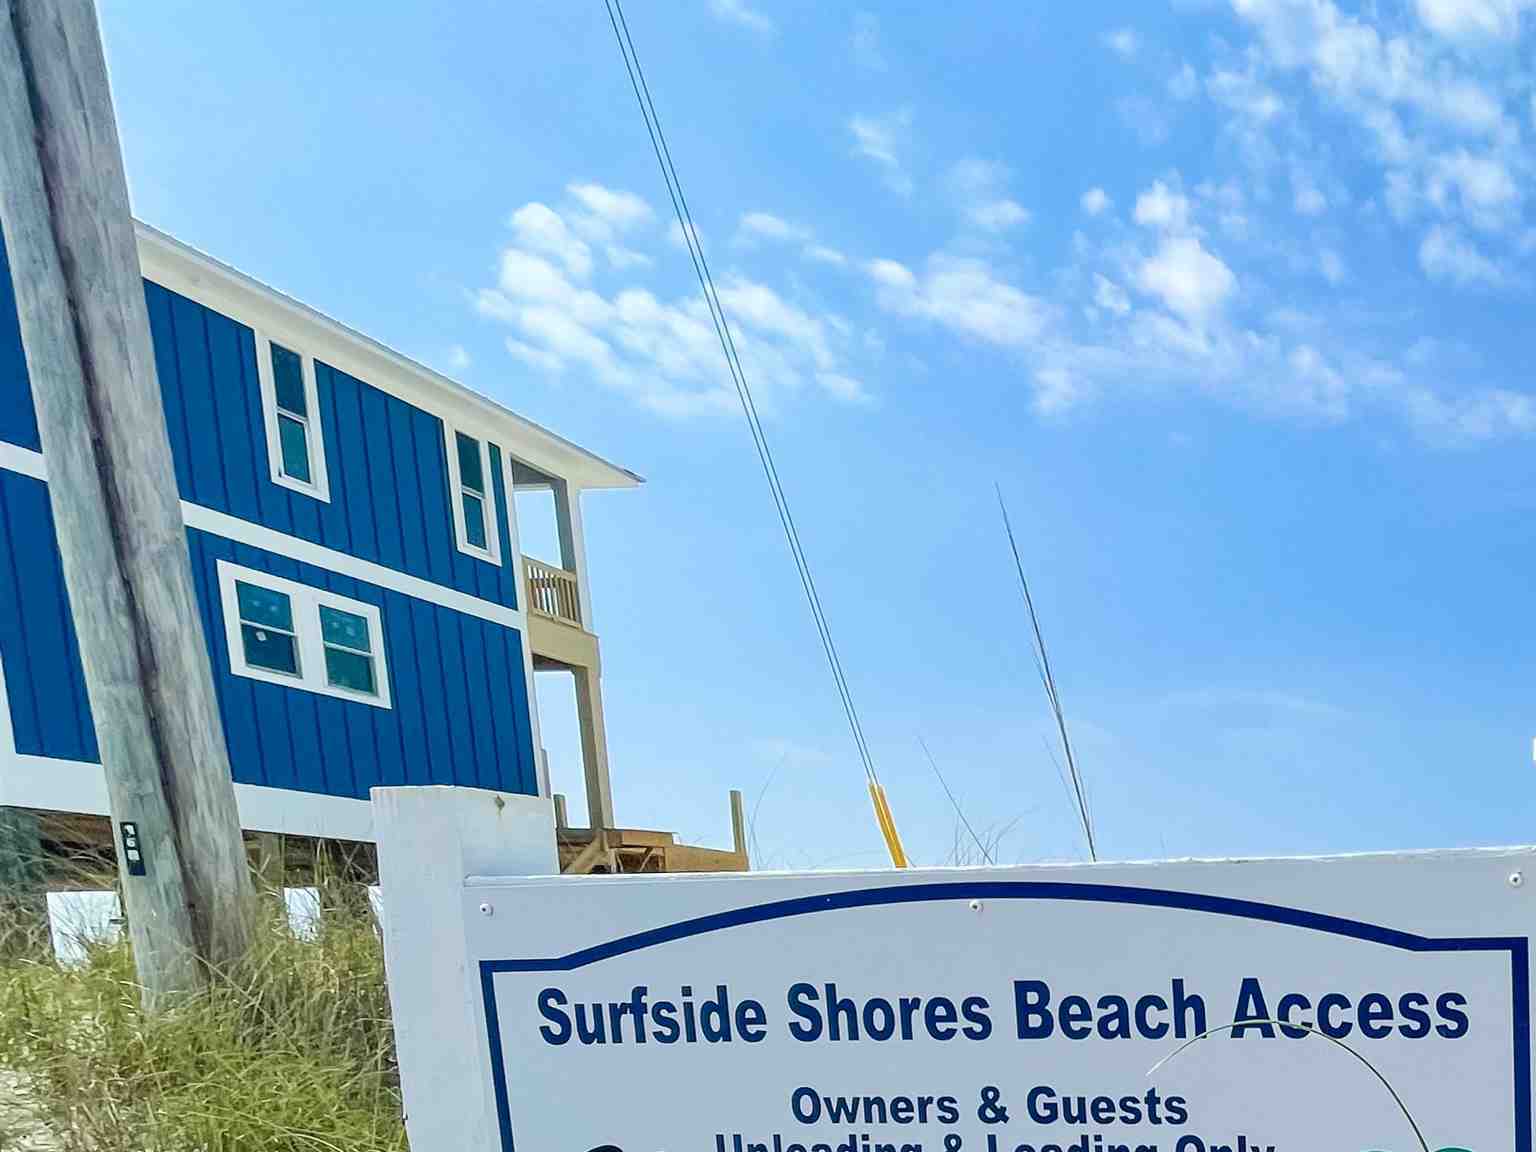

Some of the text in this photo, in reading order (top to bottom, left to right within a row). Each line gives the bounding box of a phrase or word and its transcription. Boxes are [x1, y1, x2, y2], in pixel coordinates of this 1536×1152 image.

[537, 977, 1469, 1046] Surfside Shores Beach Access
[791, 1085, 1188, 1126] Owners & Guests
